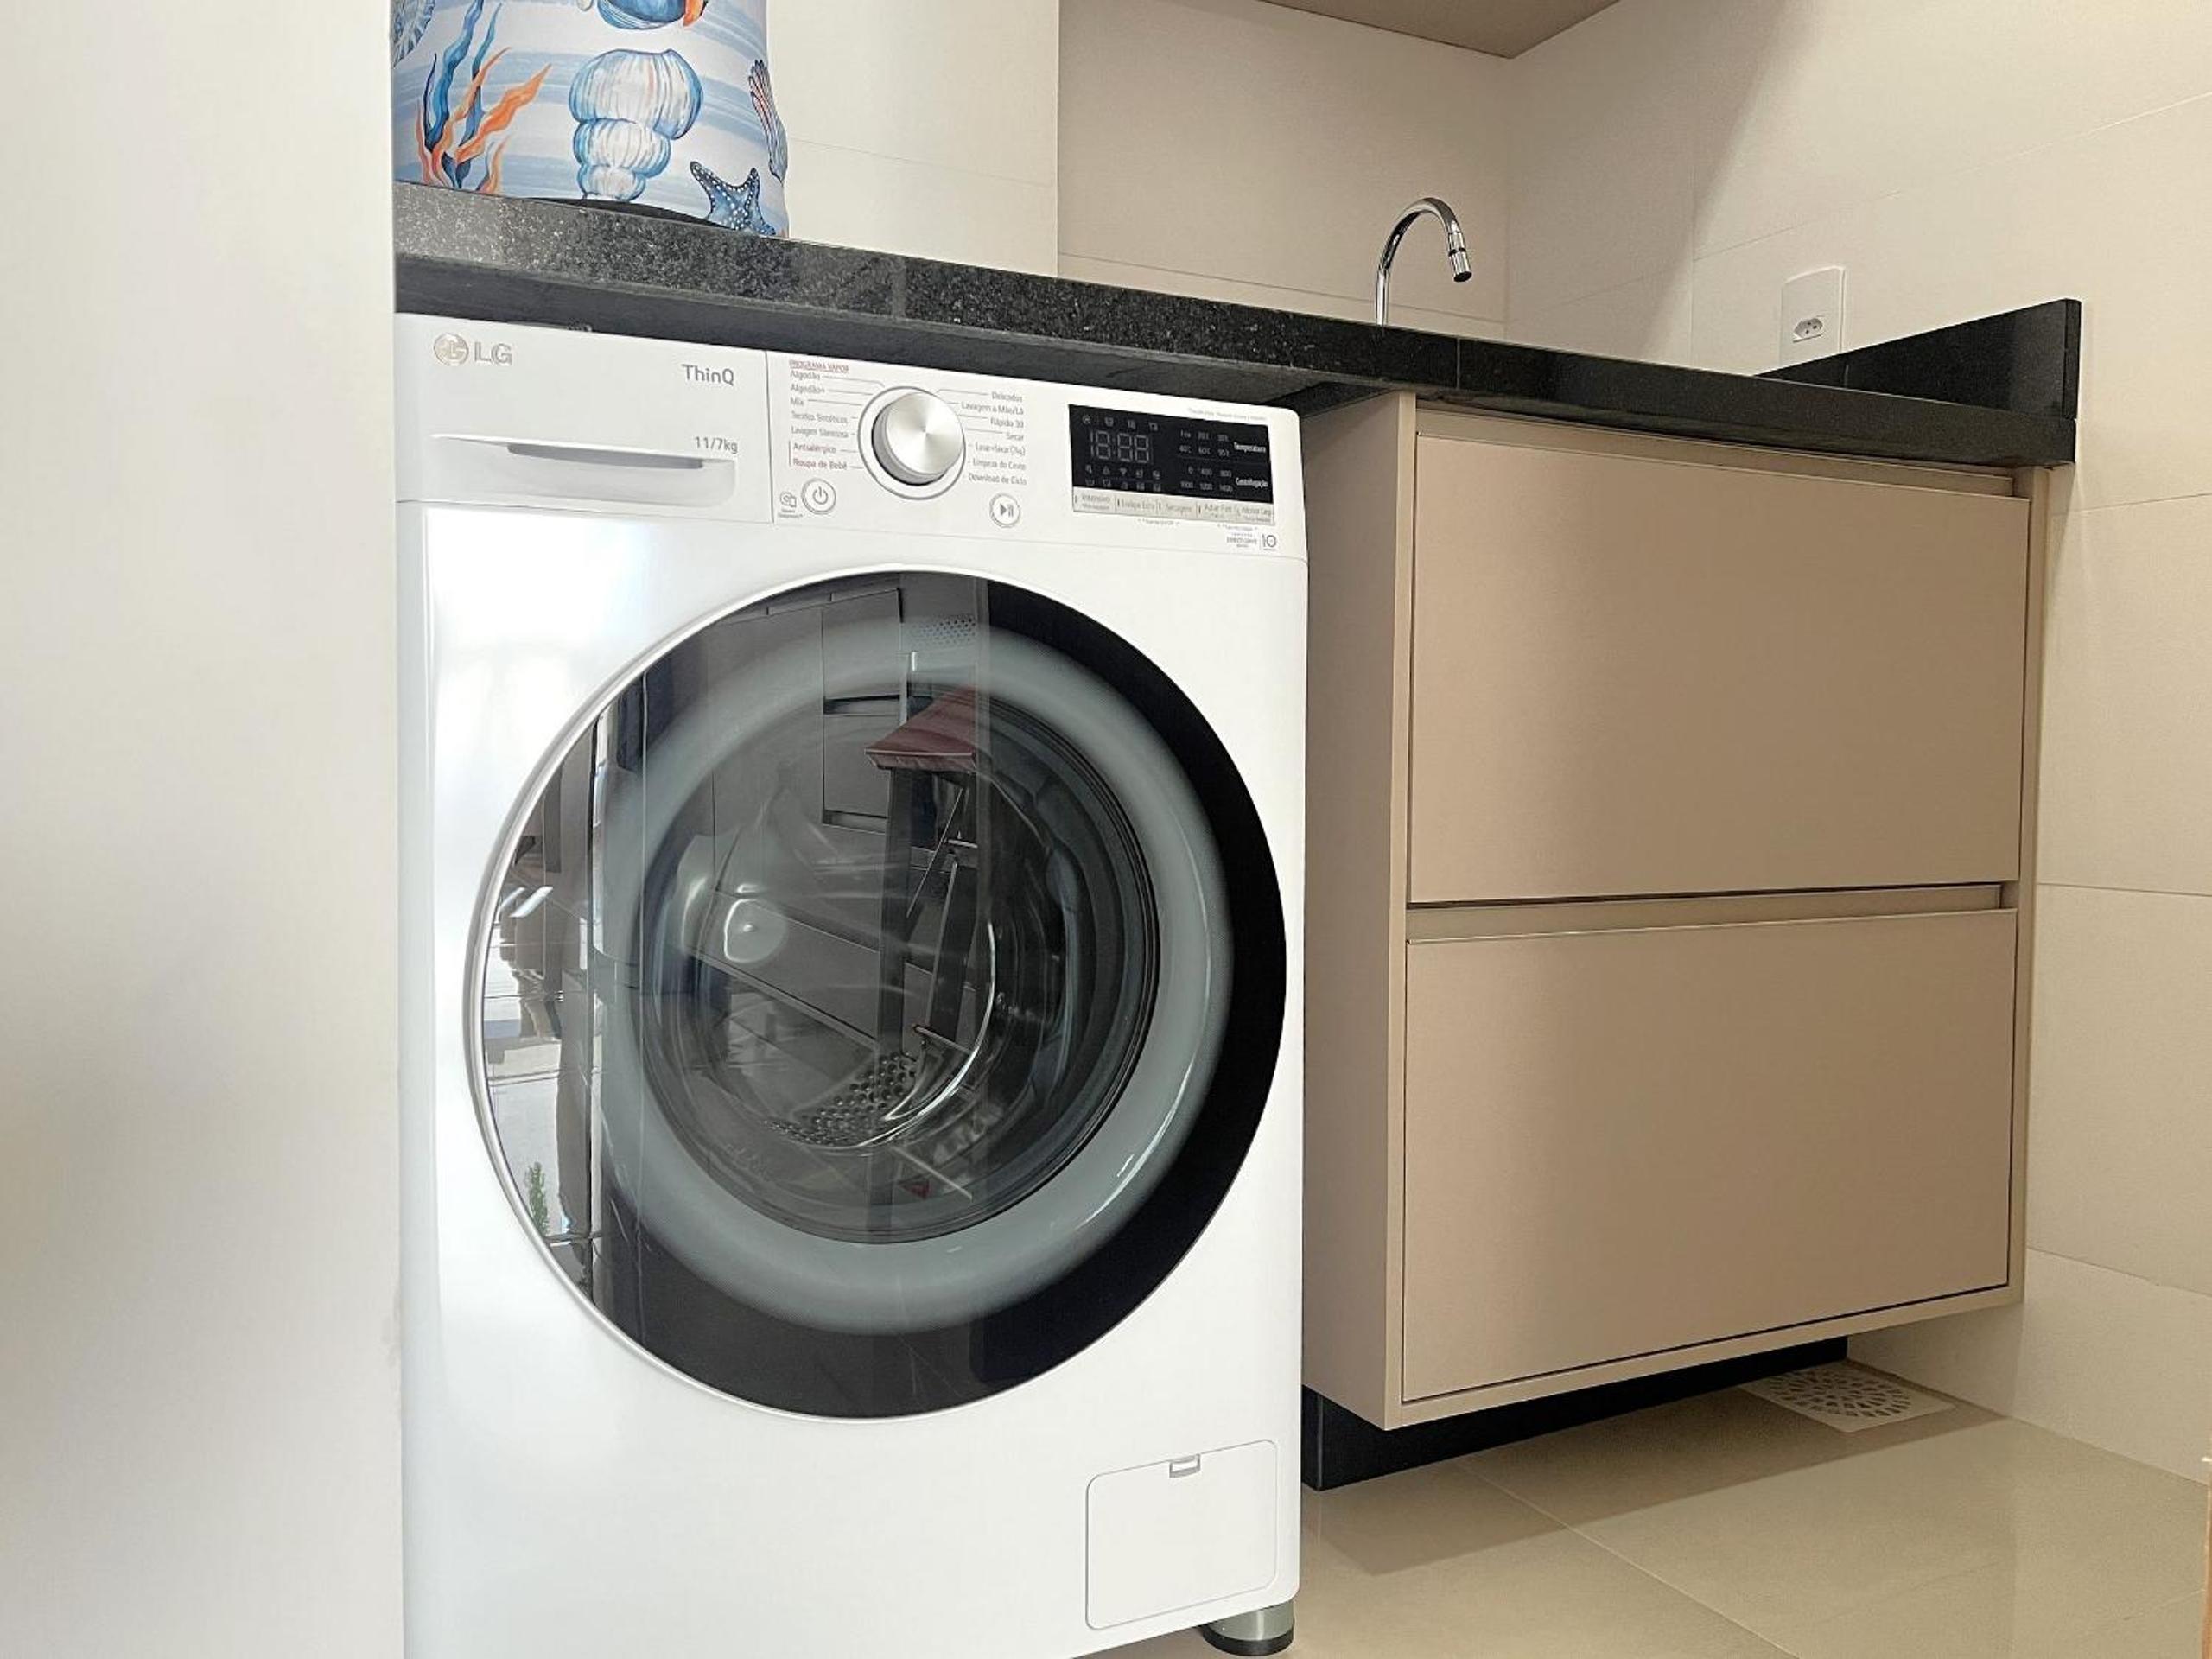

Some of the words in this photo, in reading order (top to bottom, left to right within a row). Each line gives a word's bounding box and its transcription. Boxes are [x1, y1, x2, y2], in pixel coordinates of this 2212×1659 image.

[474, 341, 512, 365] LG
[681, 364, 734, 386] ThinQ
[695, 435, 738, 454] 11/7kg
[817, 460, 827, 468] de
